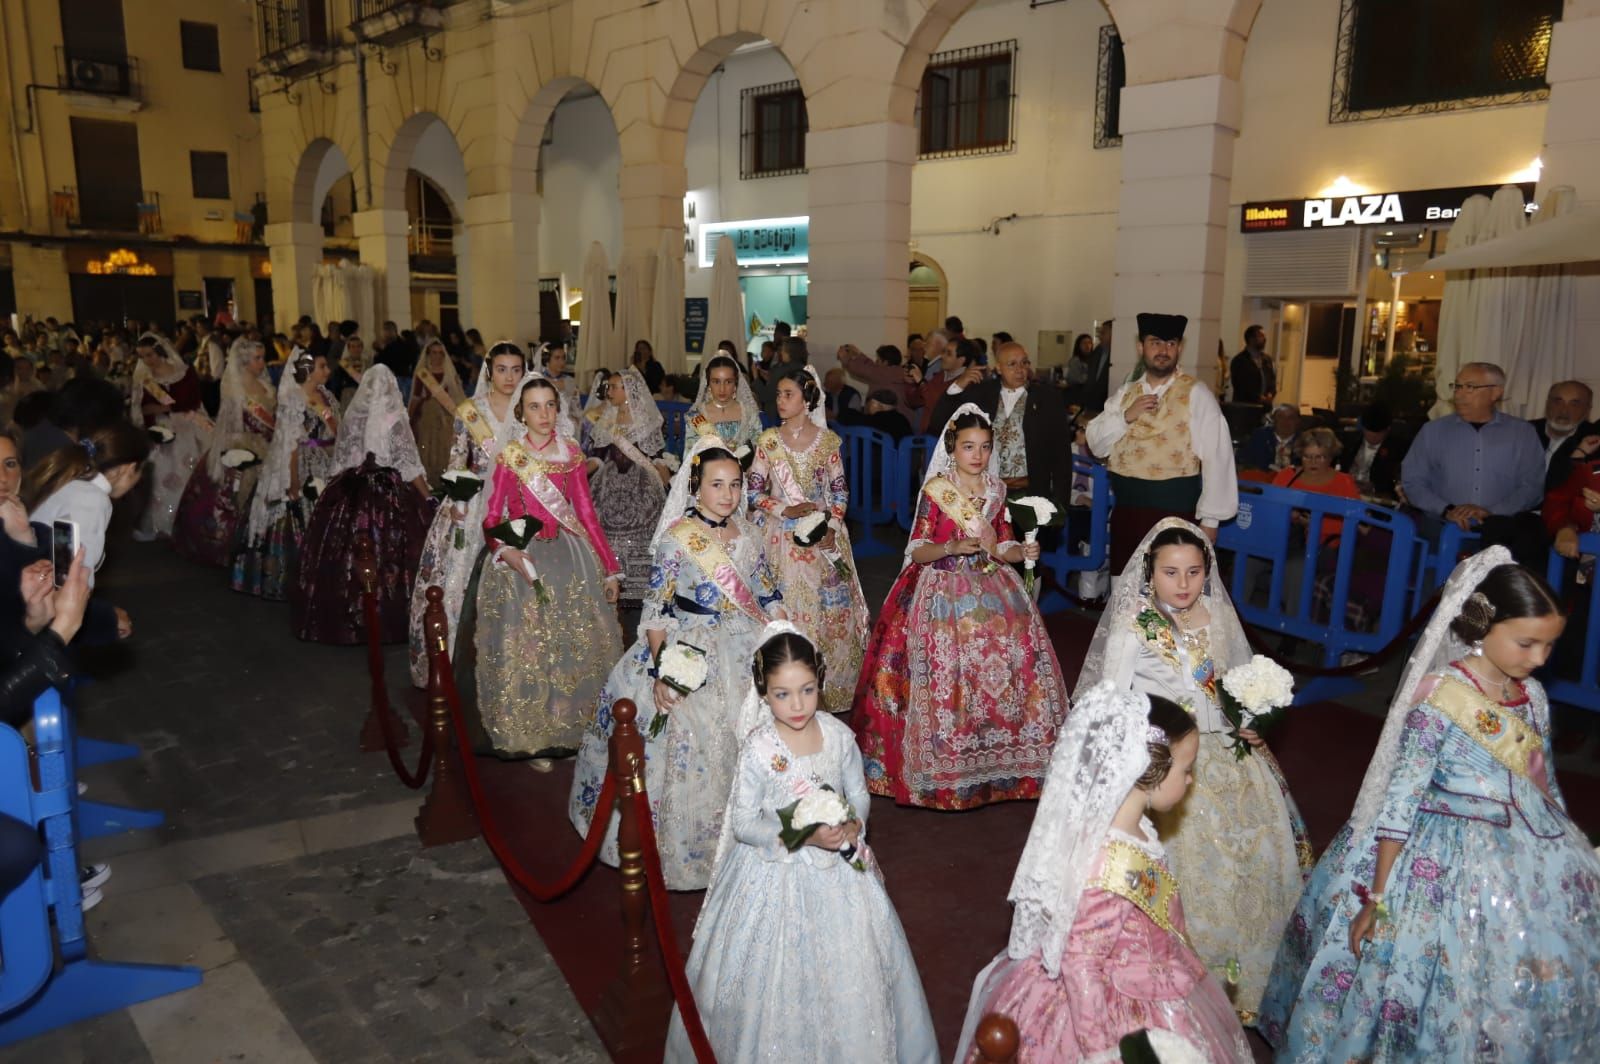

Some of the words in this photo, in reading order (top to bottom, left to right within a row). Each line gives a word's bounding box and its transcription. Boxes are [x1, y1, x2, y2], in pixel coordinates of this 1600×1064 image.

[1246, 207, 1288, 220] Mahou
[1303, 194, 1404, 227] PLAZA
[1426, 207, 1461, 220] Bar
